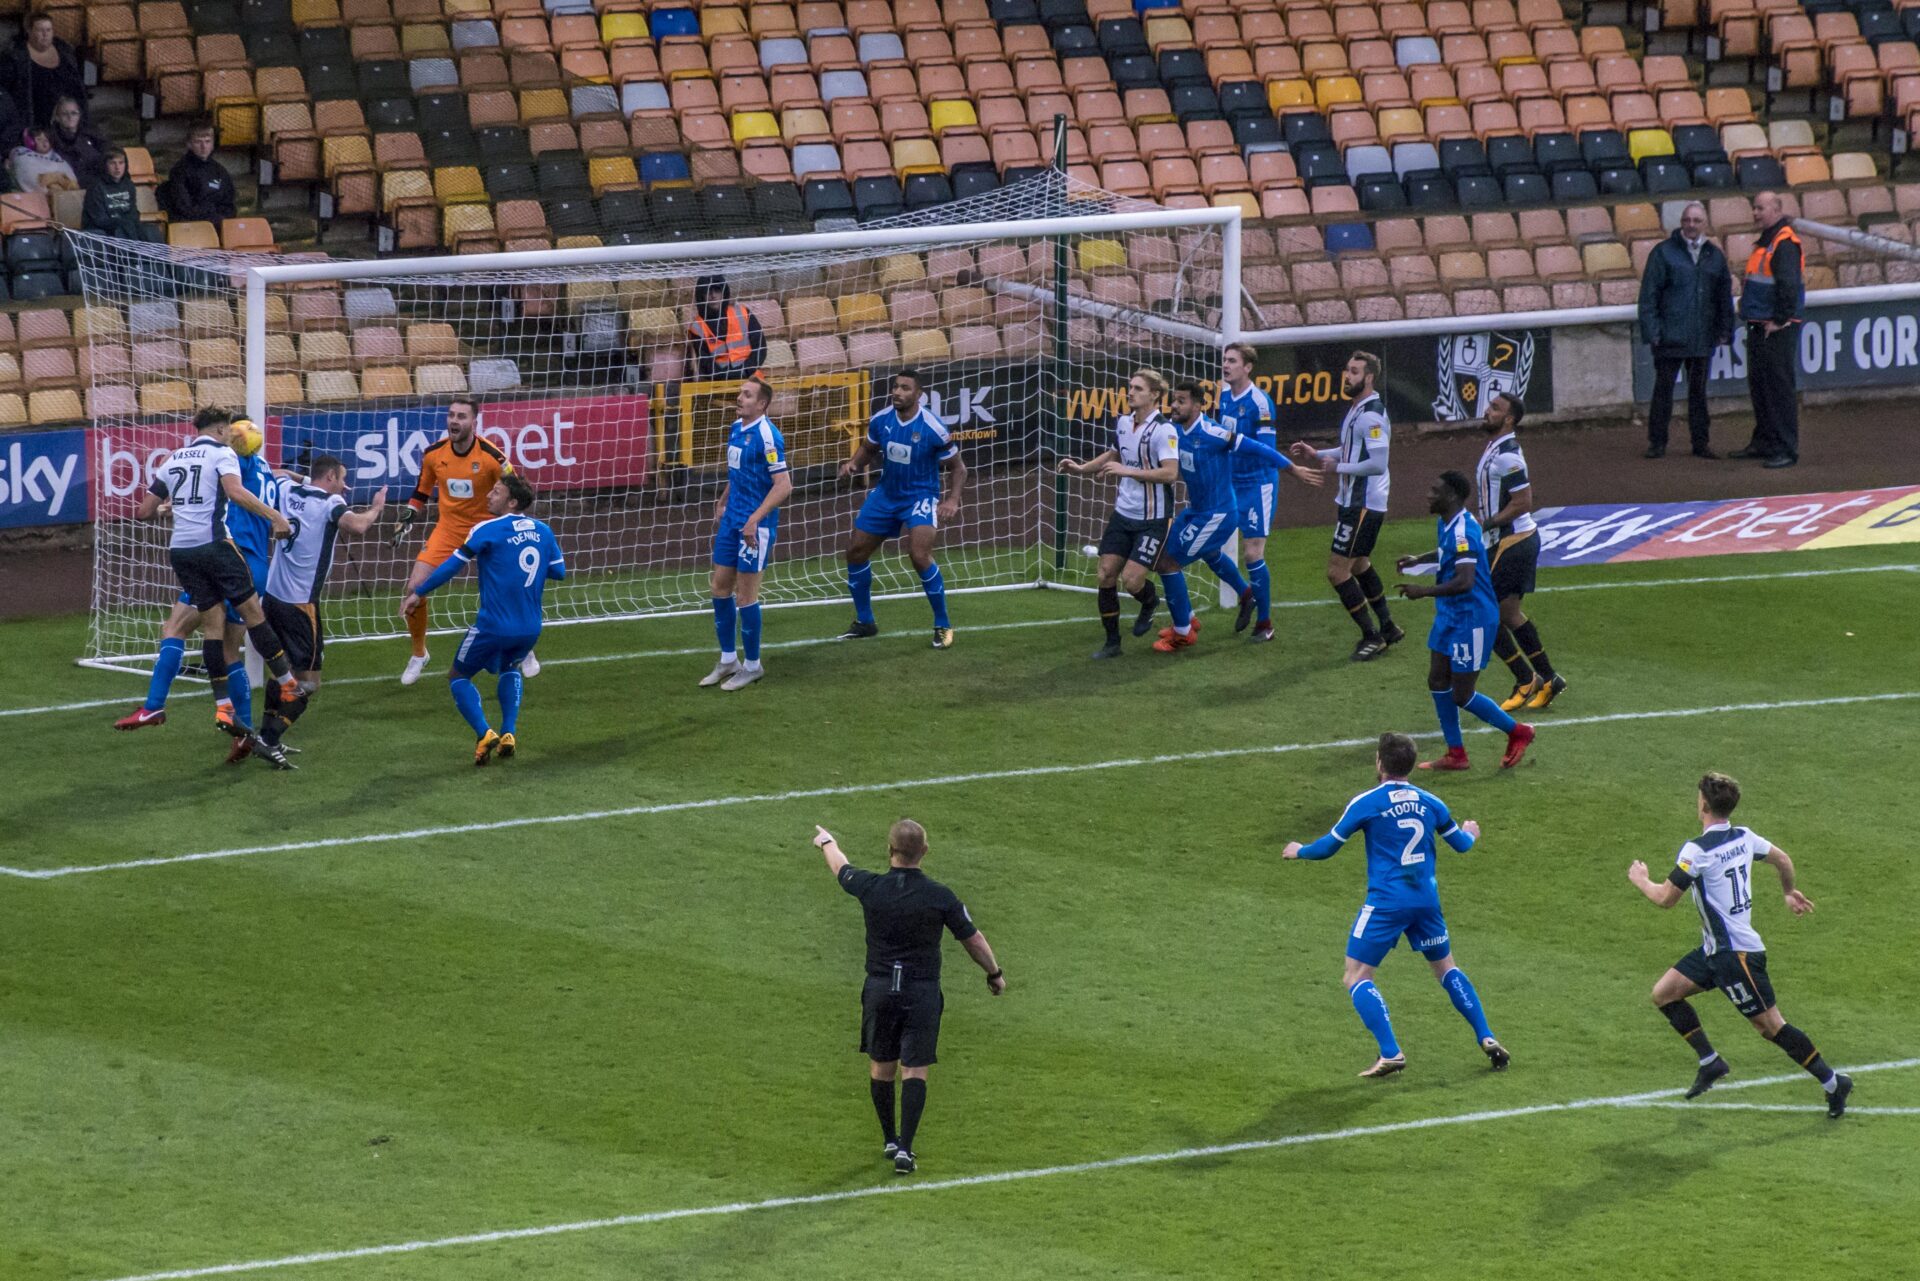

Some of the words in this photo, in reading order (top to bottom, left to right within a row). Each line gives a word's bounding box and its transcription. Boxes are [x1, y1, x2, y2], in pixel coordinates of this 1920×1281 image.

[1801, 320, 1842, 374] OF
[919, 386, 997, 425] LK
[173, 449, 206, 461] VASSELL
[477, 412, 577, 470] bet
[169, 465, 204, 505] 21
[912, 497, 931, 516] 26
[1665, 495, 1875, 543] bet
[511, 530, 541, 545] DENNIS
[1137, 535, 1160, 556] 15
[519, 546, 540, 588] 9
[1453, 643, 1472, 661] 11
[1387, 801, 1428, 818] TOOTLE
[1397, 818, 1426, 866] 2
[1725, 863, 1753, 915] 11
